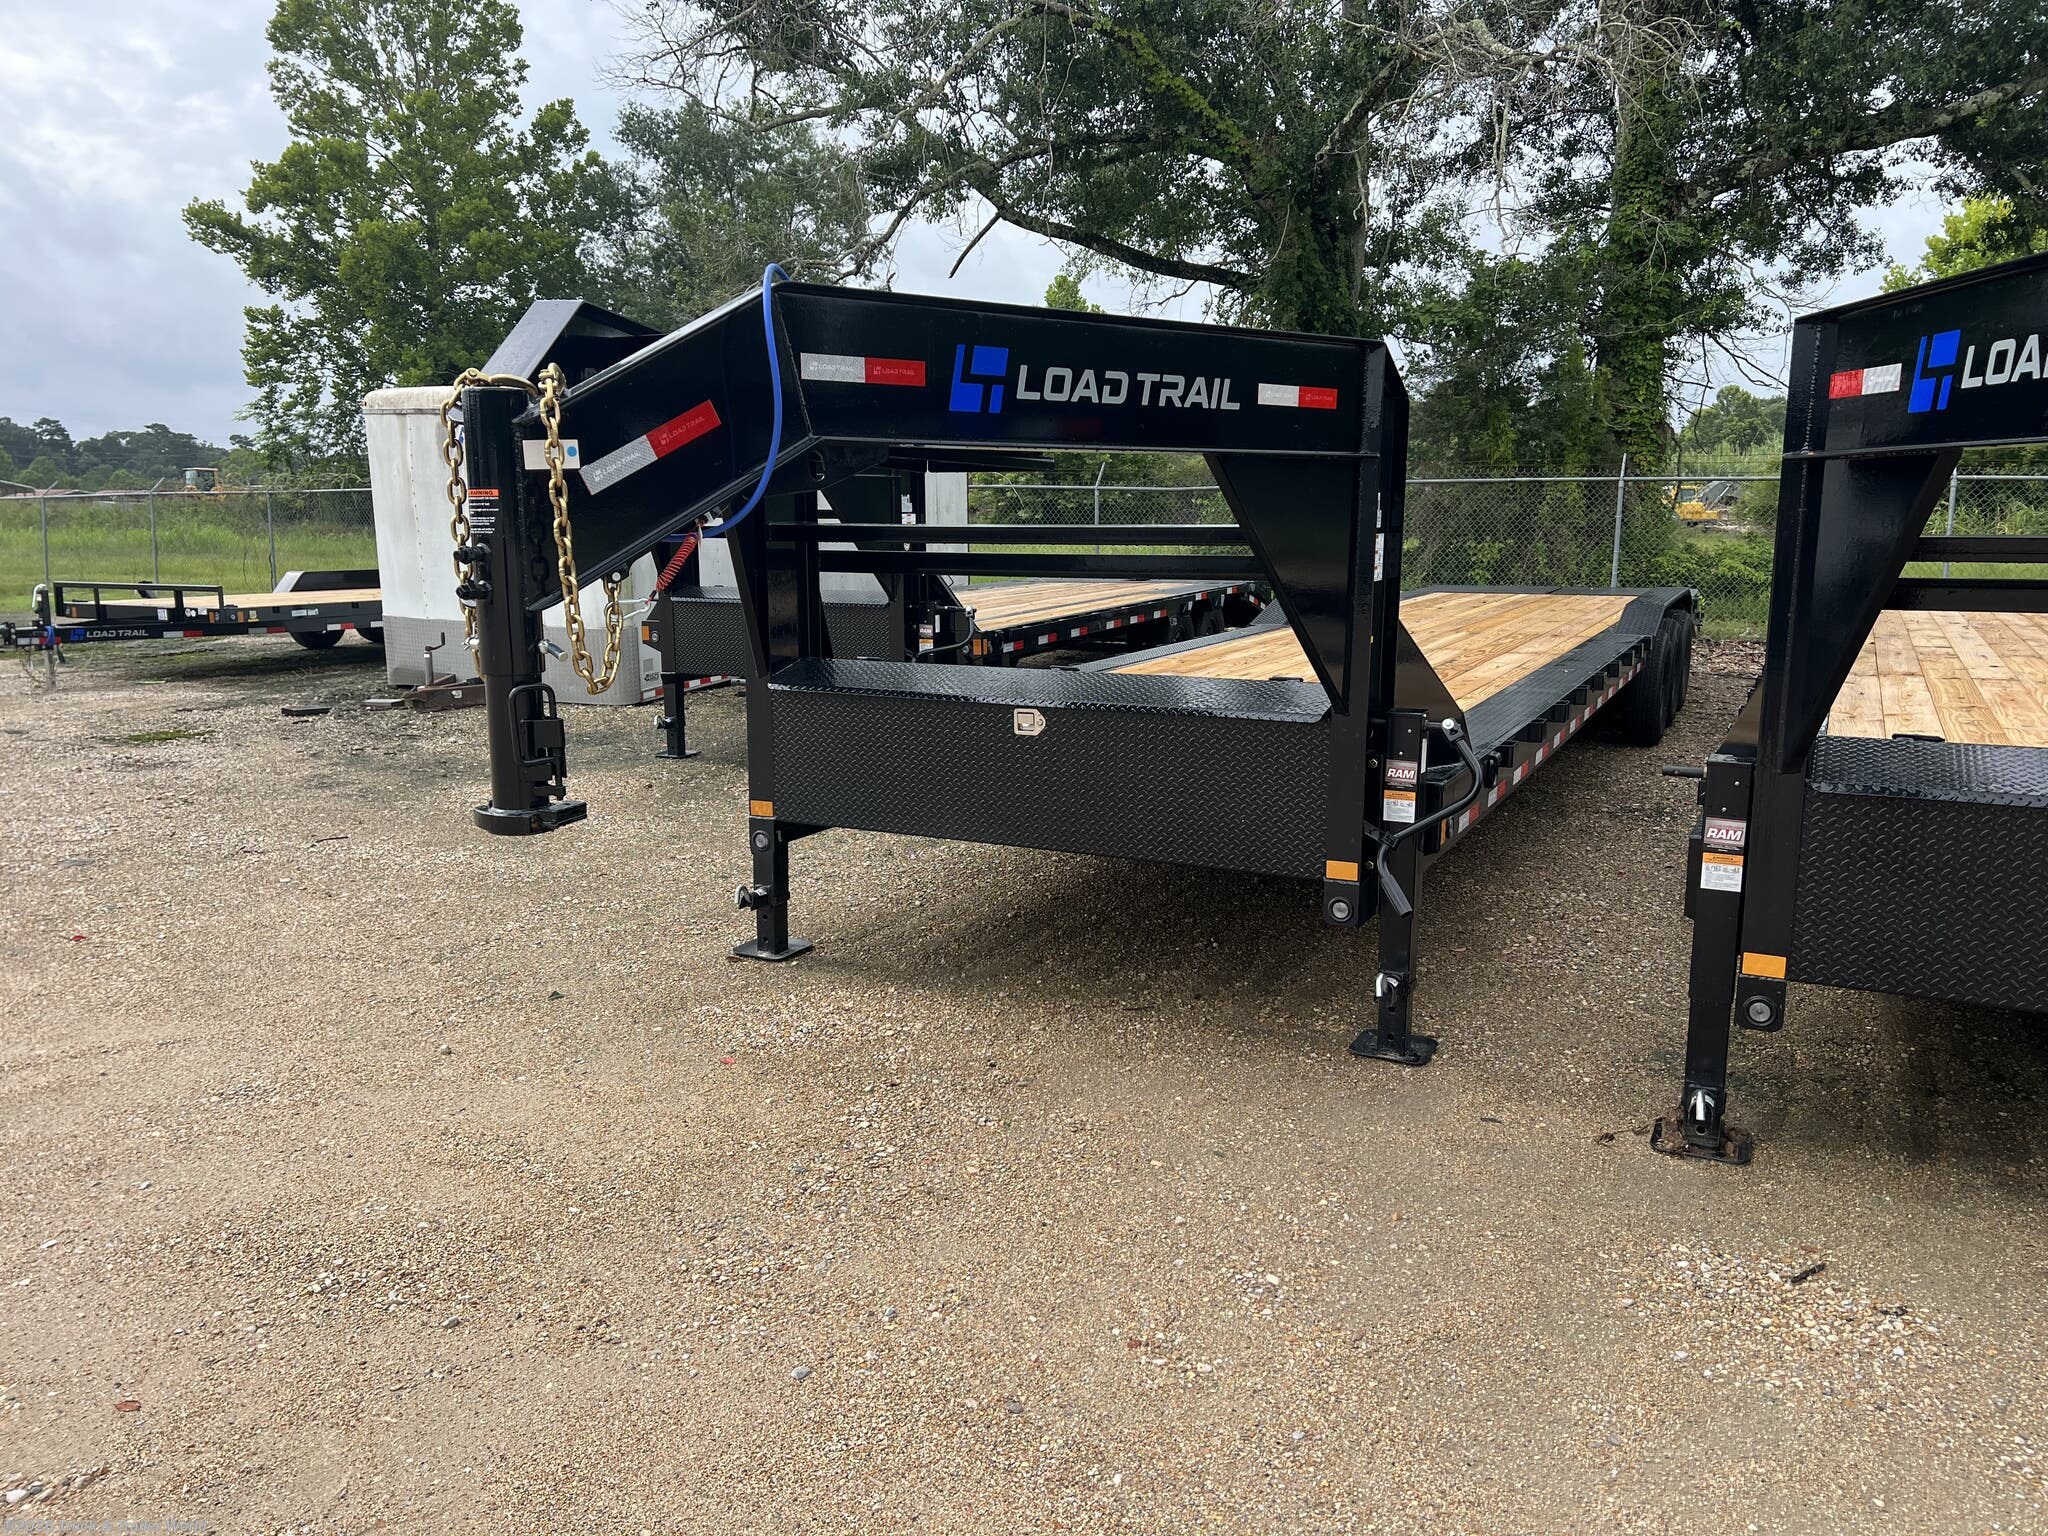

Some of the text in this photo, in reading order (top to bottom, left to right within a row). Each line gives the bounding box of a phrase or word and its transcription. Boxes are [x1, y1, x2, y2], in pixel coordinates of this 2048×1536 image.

[1961, 334, 2048, 389] LOA
[1016, 364, 1241, 410] LOAD TRAIL
[86, 629, 149, 638] LOAD TRAIL
[1387, 768, 1415, 779] RAM
[1706, 827, 1742, 841] RAM
